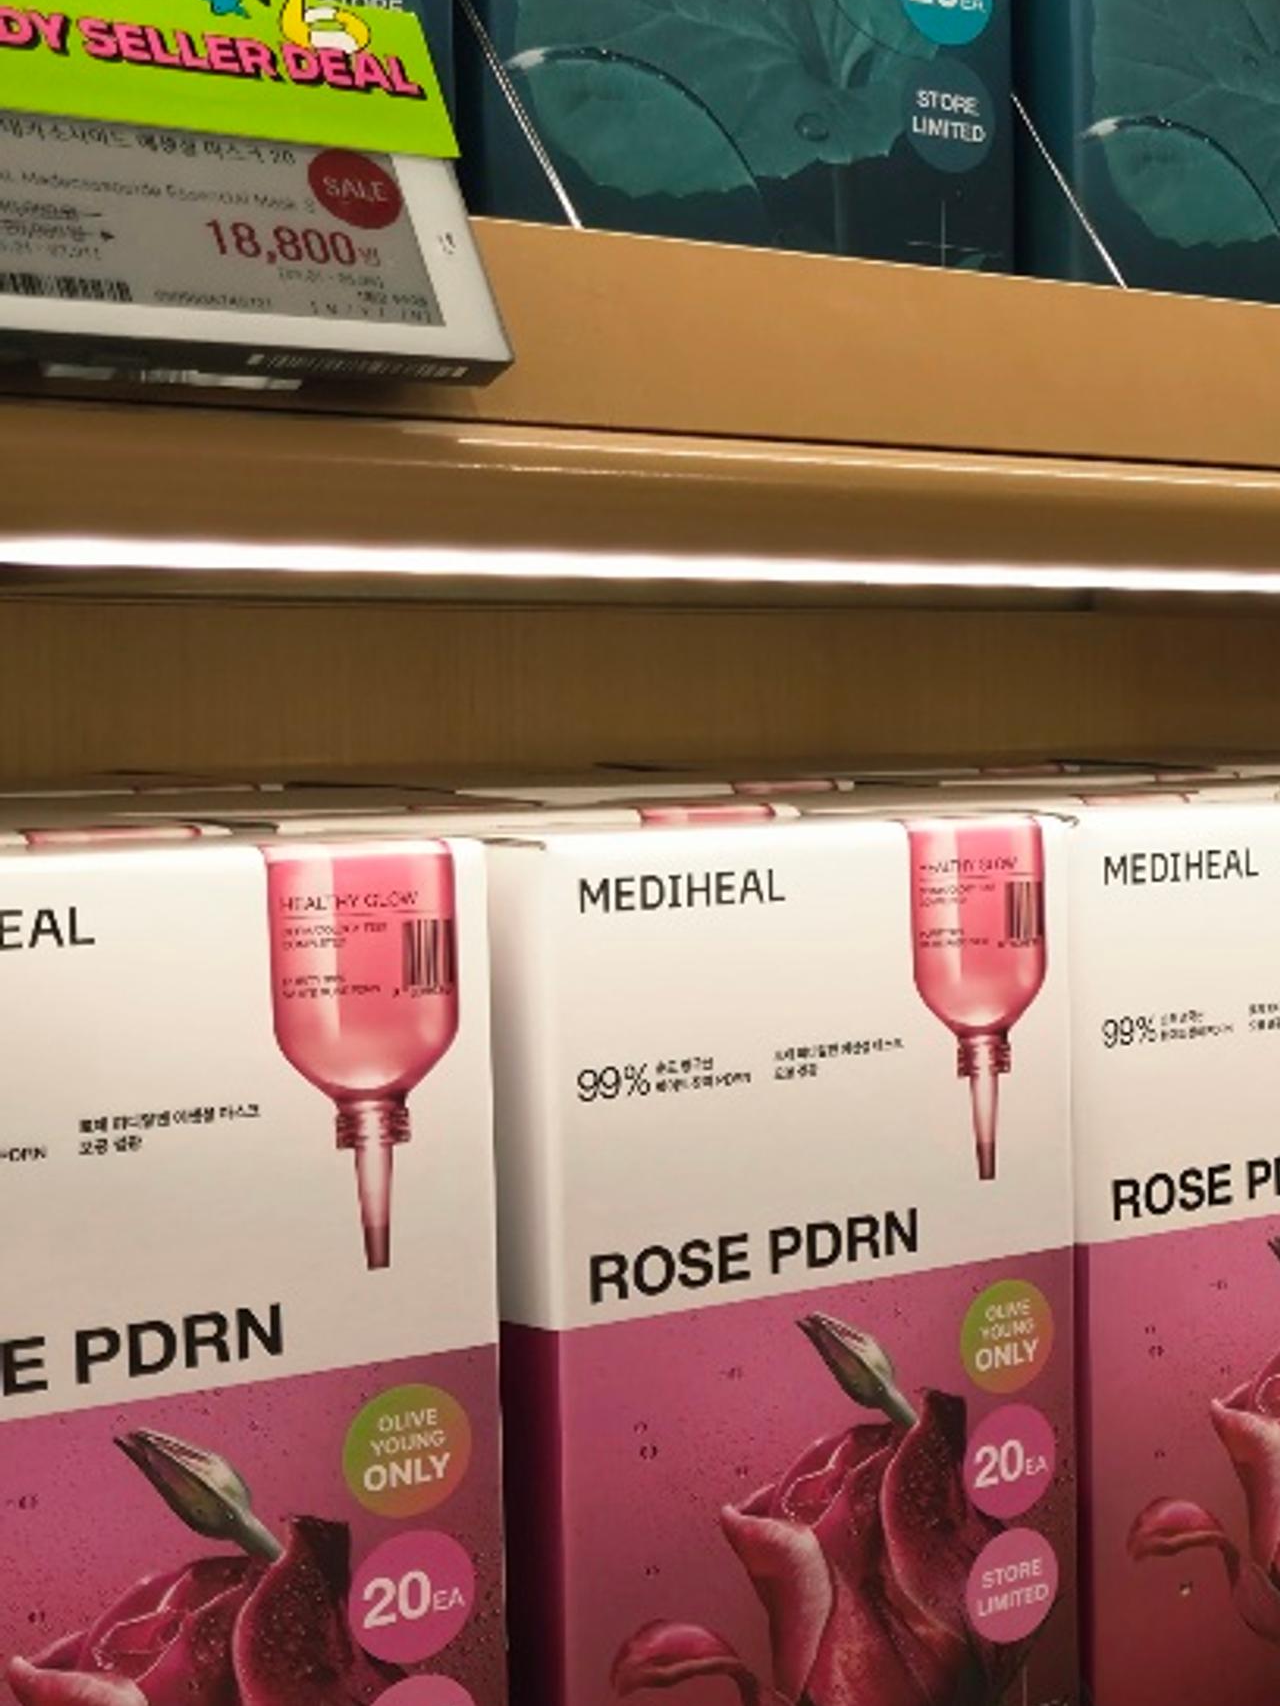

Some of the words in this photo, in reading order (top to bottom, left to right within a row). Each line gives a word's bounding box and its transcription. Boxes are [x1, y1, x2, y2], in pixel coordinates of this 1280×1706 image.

[81, 17, 277, 79] SELLER
[283, 45, 427, 99] DEAL
[915, 88, 979, 119] STORE
[910, 108, 987, 147] LIMITED
[321, 173, 391, 205] SALE
[1102, 848, 1260, 886] MEDIHEAL
[578, 867, 787, 915] MEDIHEAL
[1100, 1012, 1158, 1049] 99%
[576, 1061, 652, 1104] 99%
[1112, 1163, 1233, 1222] ROSE
[588, 1232, 752, 1305] ROSE
[769, 1207, 920, 1276] PDRN
[74, 1302, 285, 1387] PDRN
[974, 1338, 1041, 1372] ONLY
[377, 1407, 438, 1435] OLIVE
[370, 1429, 446, 1459] YOUNG
[362, 1451, 453, 1494] ONLY
[982, 1558, 1043, 1592] STORE
[977, 1583, 1050, 1618] LIMITED
